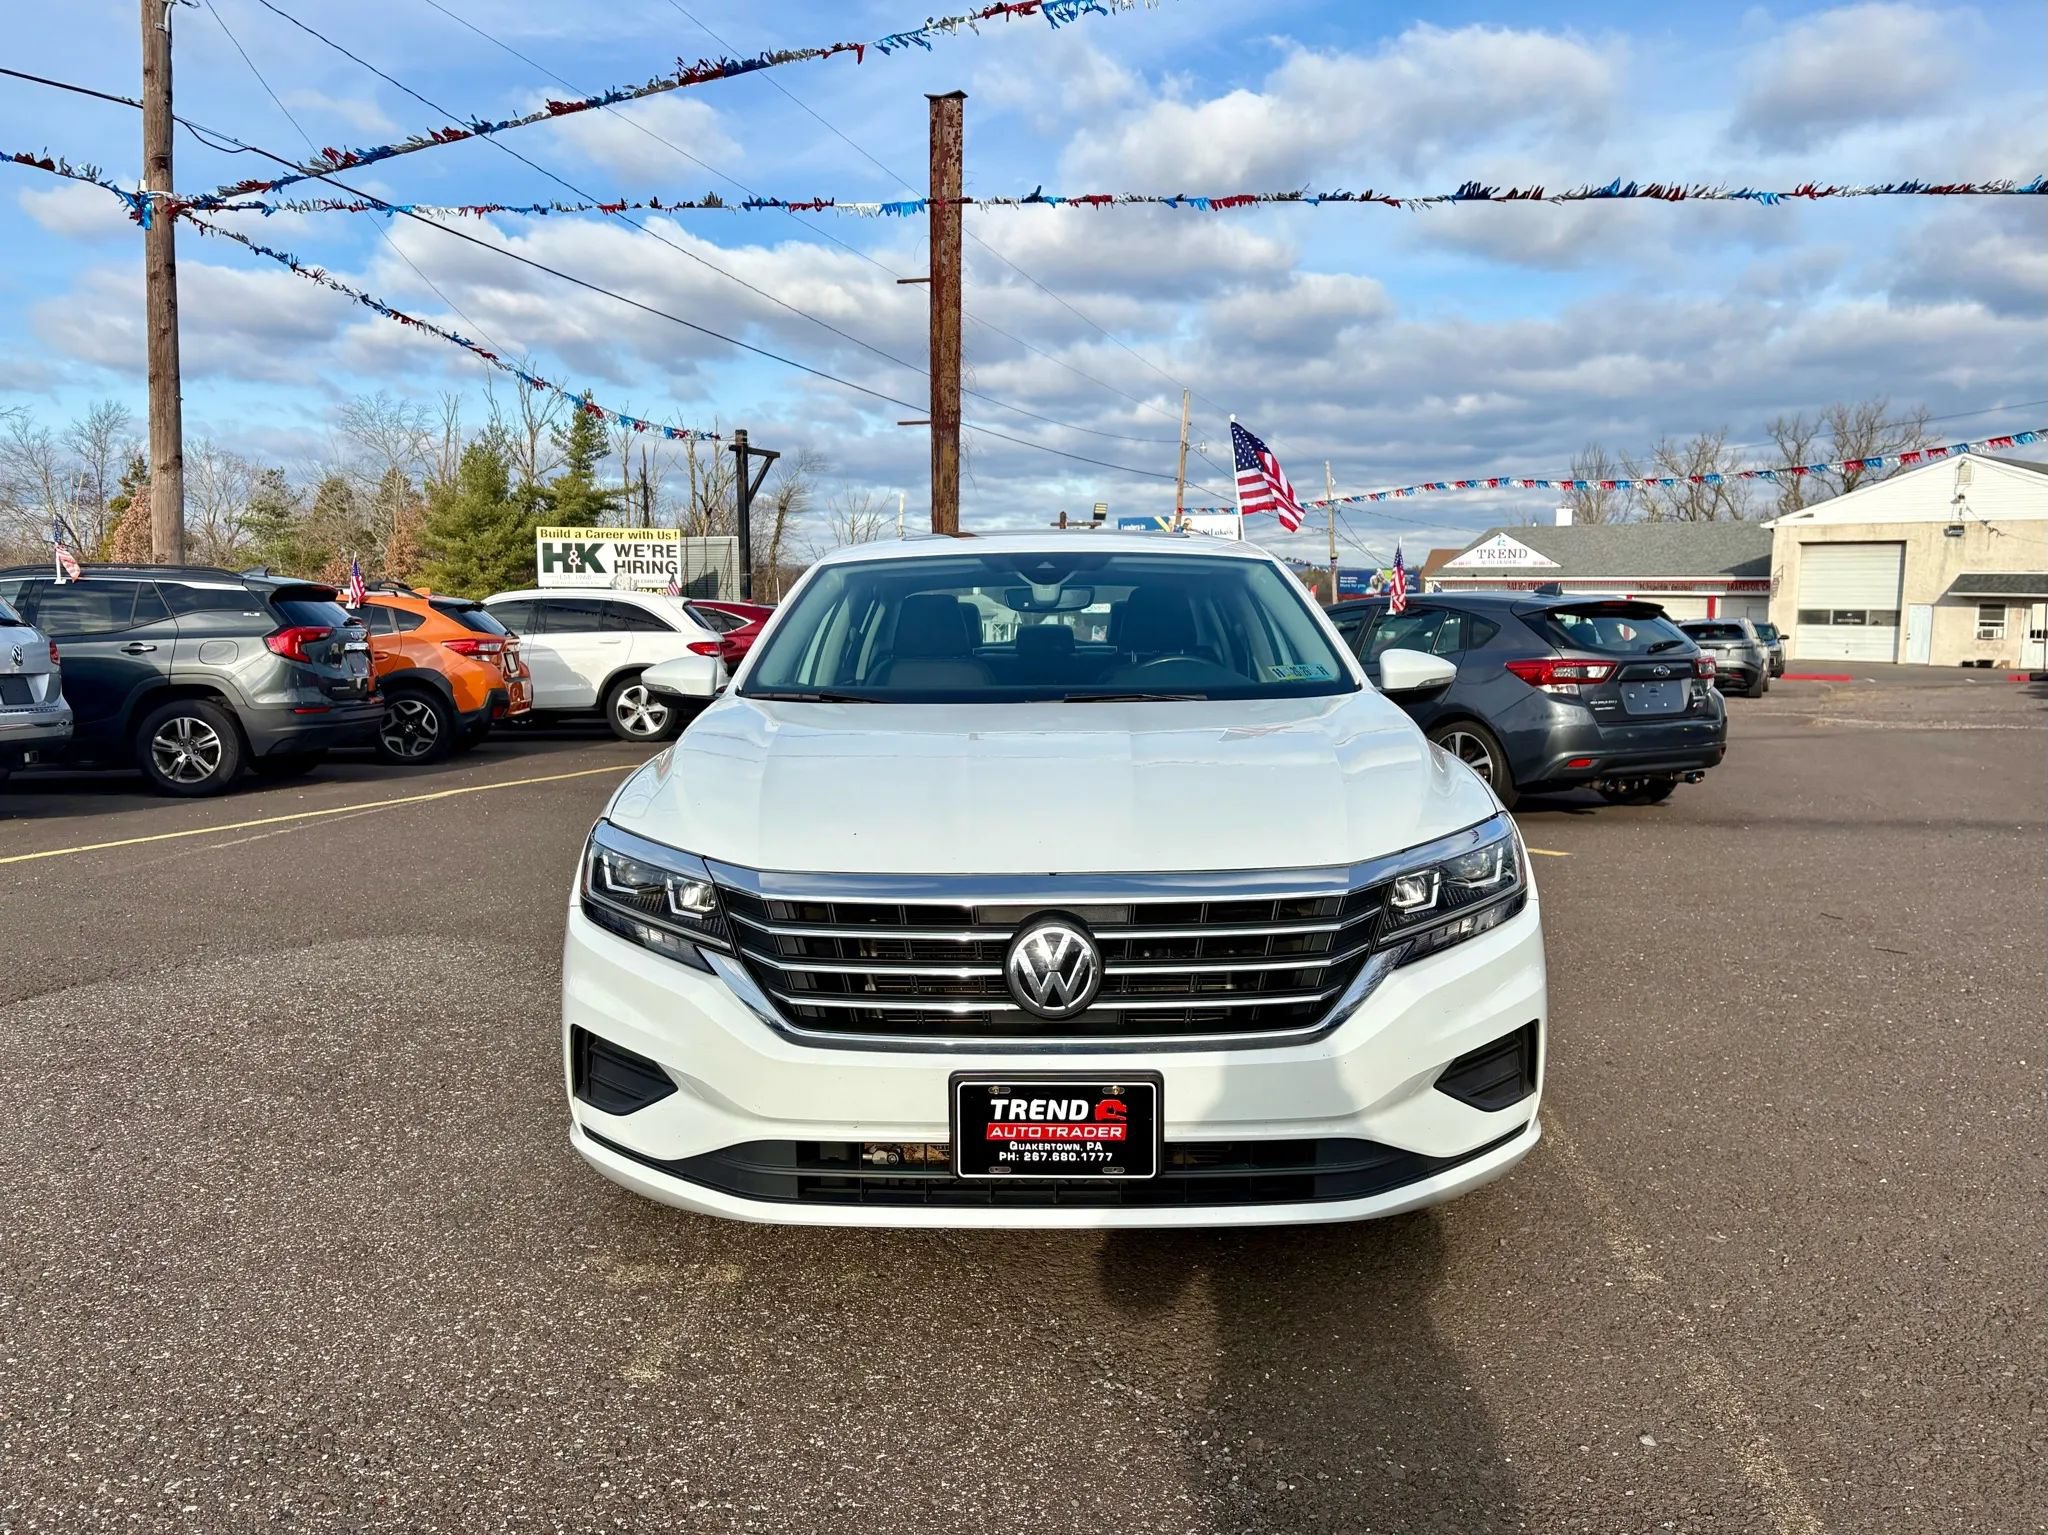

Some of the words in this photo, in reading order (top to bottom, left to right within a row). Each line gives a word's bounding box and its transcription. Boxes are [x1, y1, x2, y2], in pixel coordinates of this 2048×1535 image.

[540, 529, 571, 539] Build
[574, 531, 582, 539] a
[585, 529, 624, 539] Career
[628, 530, 656, 540] with
[614, 543, 678, 558] WE'RE
[1476, 548, 1528, 559] TREND
[542, 542, 607, 574] H&K
[614, 560, 678, 574] HIRING
[990, 1098, 1089, 1121] TREND
[989, 1126, 1042, 1138] AUTO
[1045, 1126, 1122, 1138] TRADER
[1086, 1141, 1103, 1151] PA
[999, 1152, 1020, 1161] PH:
[1023, 1152, 1113, 1161] 267.680.1777
